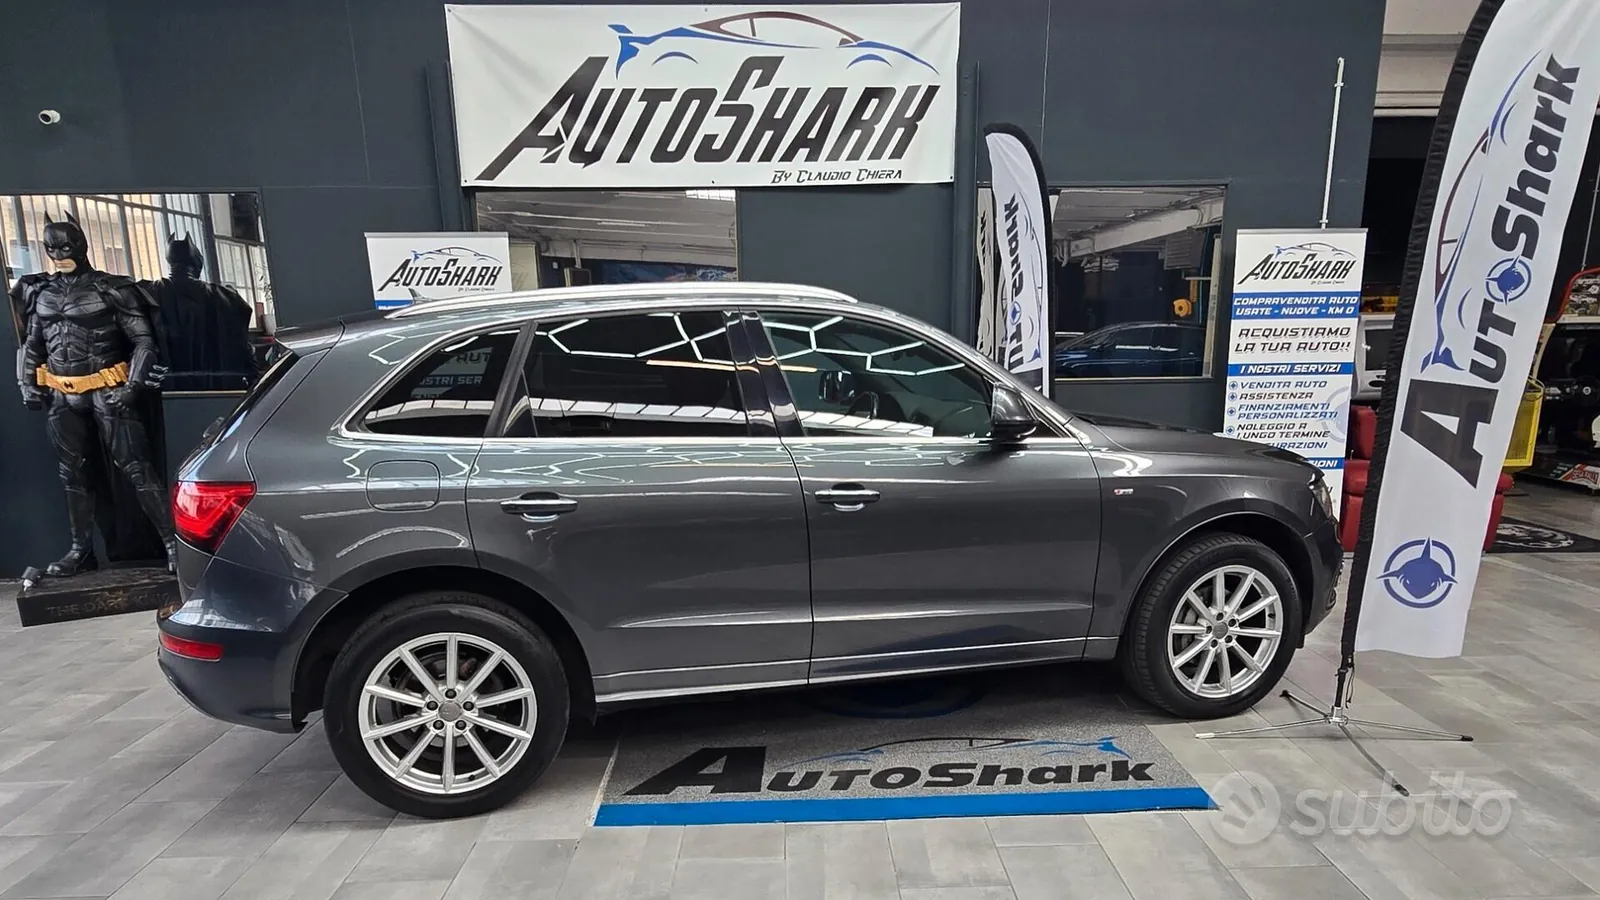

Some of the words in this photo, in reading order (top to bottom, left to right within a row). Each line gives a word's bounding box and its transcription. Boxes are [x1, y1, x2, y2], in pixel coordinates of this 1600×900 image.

[1233, 296, 1327, 305] COMPRAVENDITA
[1329, 296, 1359, 304] AUTO
[1236, 307, 1273, 316] USATE
[1281, 306, 1320, 315] NUOVE
[1328, 306, 1344, 314] KM
[1238, 327, 1351, 338] ACQUISTIAMO
[1234, 342, 1256, 352] LA
[1261, 342, 1292, 352] TUA
[1296, 341, 1351, 351] AUTO!!
[1240, 365, 1246, 374] I
[1247, 364, 1292, 374] NOSTRI
[1293, 364, 1341, 373] SERVIZI
[1240, 381, 1291, 389] VENDITA
[1295, 380, 1328, 389] AUTO
[1239, 392, 1314, 400] ASSISTENZA
[1238, 403, 1330, 411] FINANZIAMENTI
[1237, 411, 1338, 420] PERSONALIZZATI
[1237, 423, 1296, 431] NOLEGGIO
[1299, 422, 1308, 430] A
[1279, 430, 1331, 439] TERMINE
